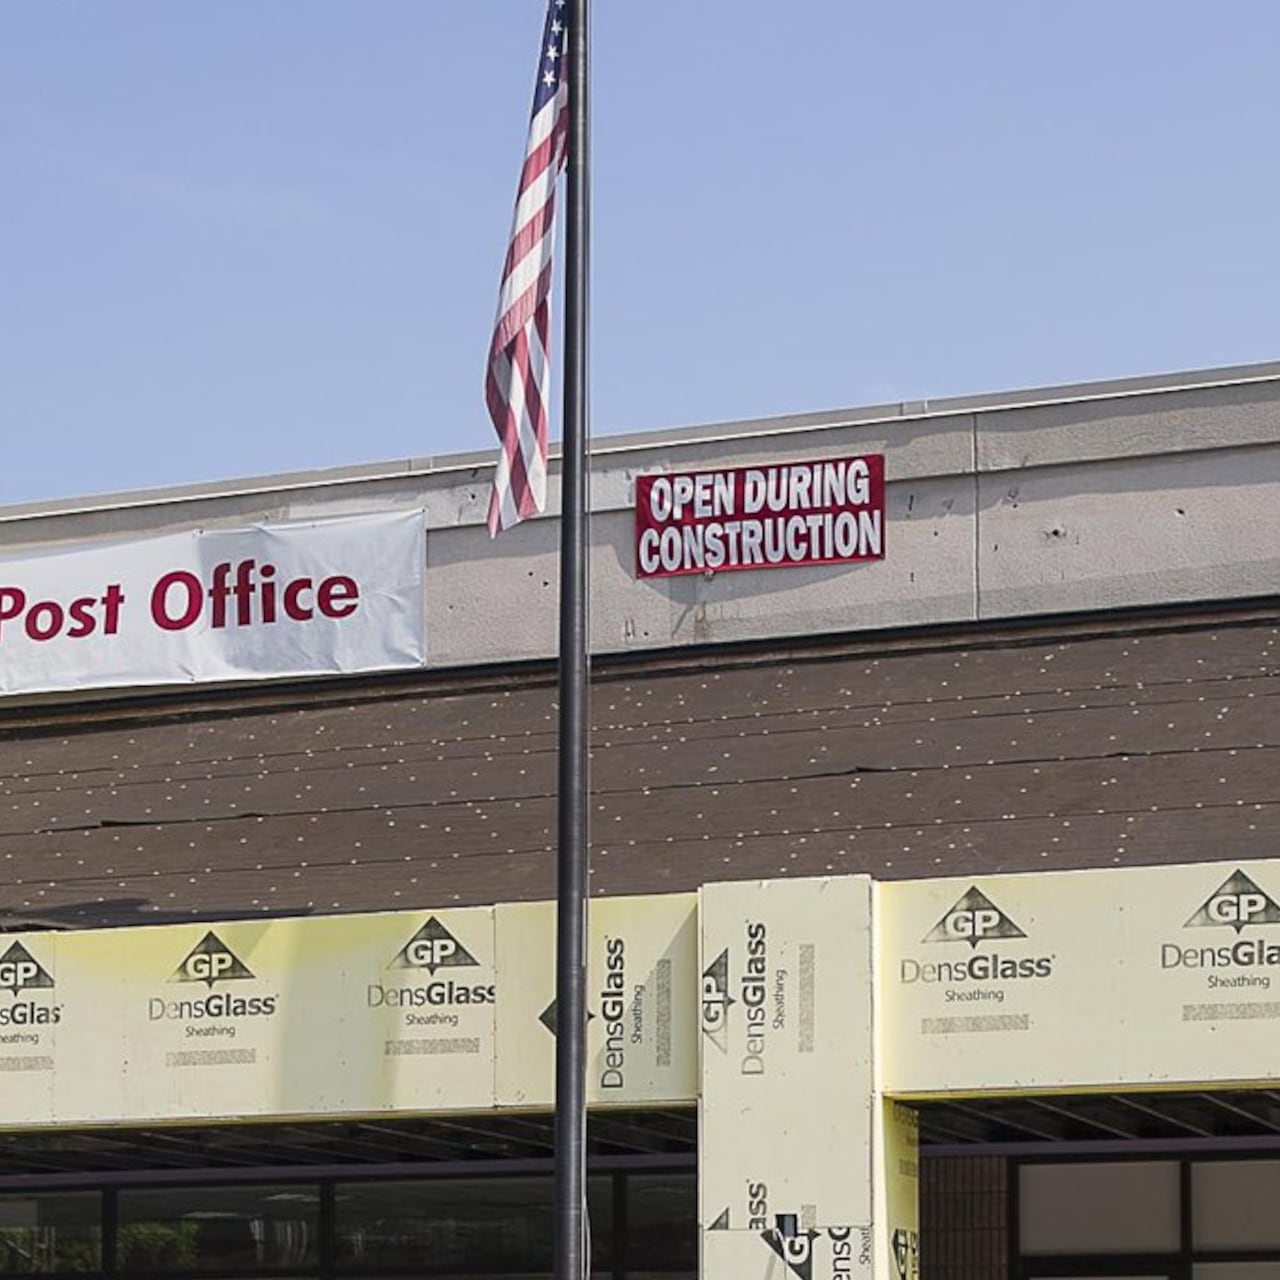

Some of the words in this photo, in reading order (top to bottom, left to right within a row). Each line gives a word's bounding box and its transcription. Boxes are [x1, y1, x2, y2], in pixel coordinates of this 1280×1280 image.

[650, 472, 735, 522] OPEN
[744, 460, 870, 513] DURING
[639, 510, 881, 574] CONSTRUCTION
[150, 558, 360, 631] Office
[1206, 893, 1267, 923] GP
[944, 909, 1001, 939] GP
[184, 952, 234, 979] GP
[407, 938, 458, 966] GP
[900, 955, 1052, 985] DensGlass
[1207, 974, 1271, 990] Sheathing
[148, 994, 276, 1021] DensGlass
[741, 921, 766, 1076] DensGlass
[773, 968, 789, 1031] Sheathing
[945, 988, 1005, 1003] Sheathing
[406, 1013, 459, 1027] Sheathing
[601, 937, 624, 1089] DensGlass
[631, 983, 646, 1045] Sheathing
[185, 1025, 236, 1038] Sheathing
